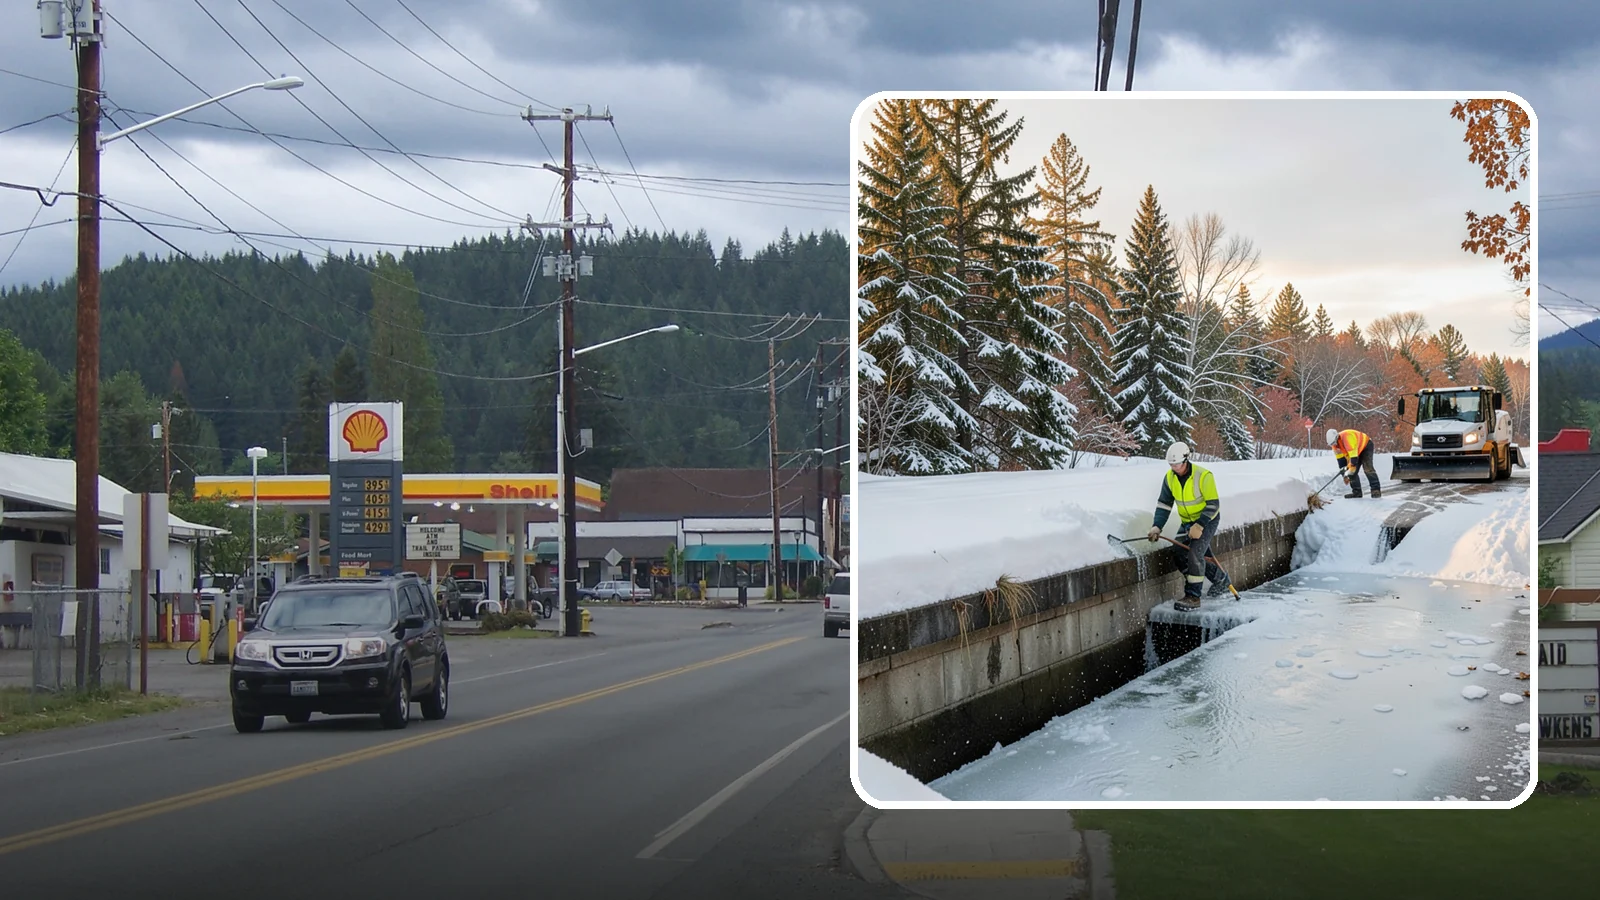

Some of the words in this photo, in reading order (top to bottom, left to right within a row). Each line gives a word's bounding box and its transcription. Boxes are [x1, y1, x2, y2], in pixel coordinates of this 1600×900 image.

[365, 480, 383, 490] 395
[490, 484, 547, 499] Shell
[365, 494, 383, 504] 405
[365, 508, 383, 518] 415
[365, 522, 383, 532] 429
